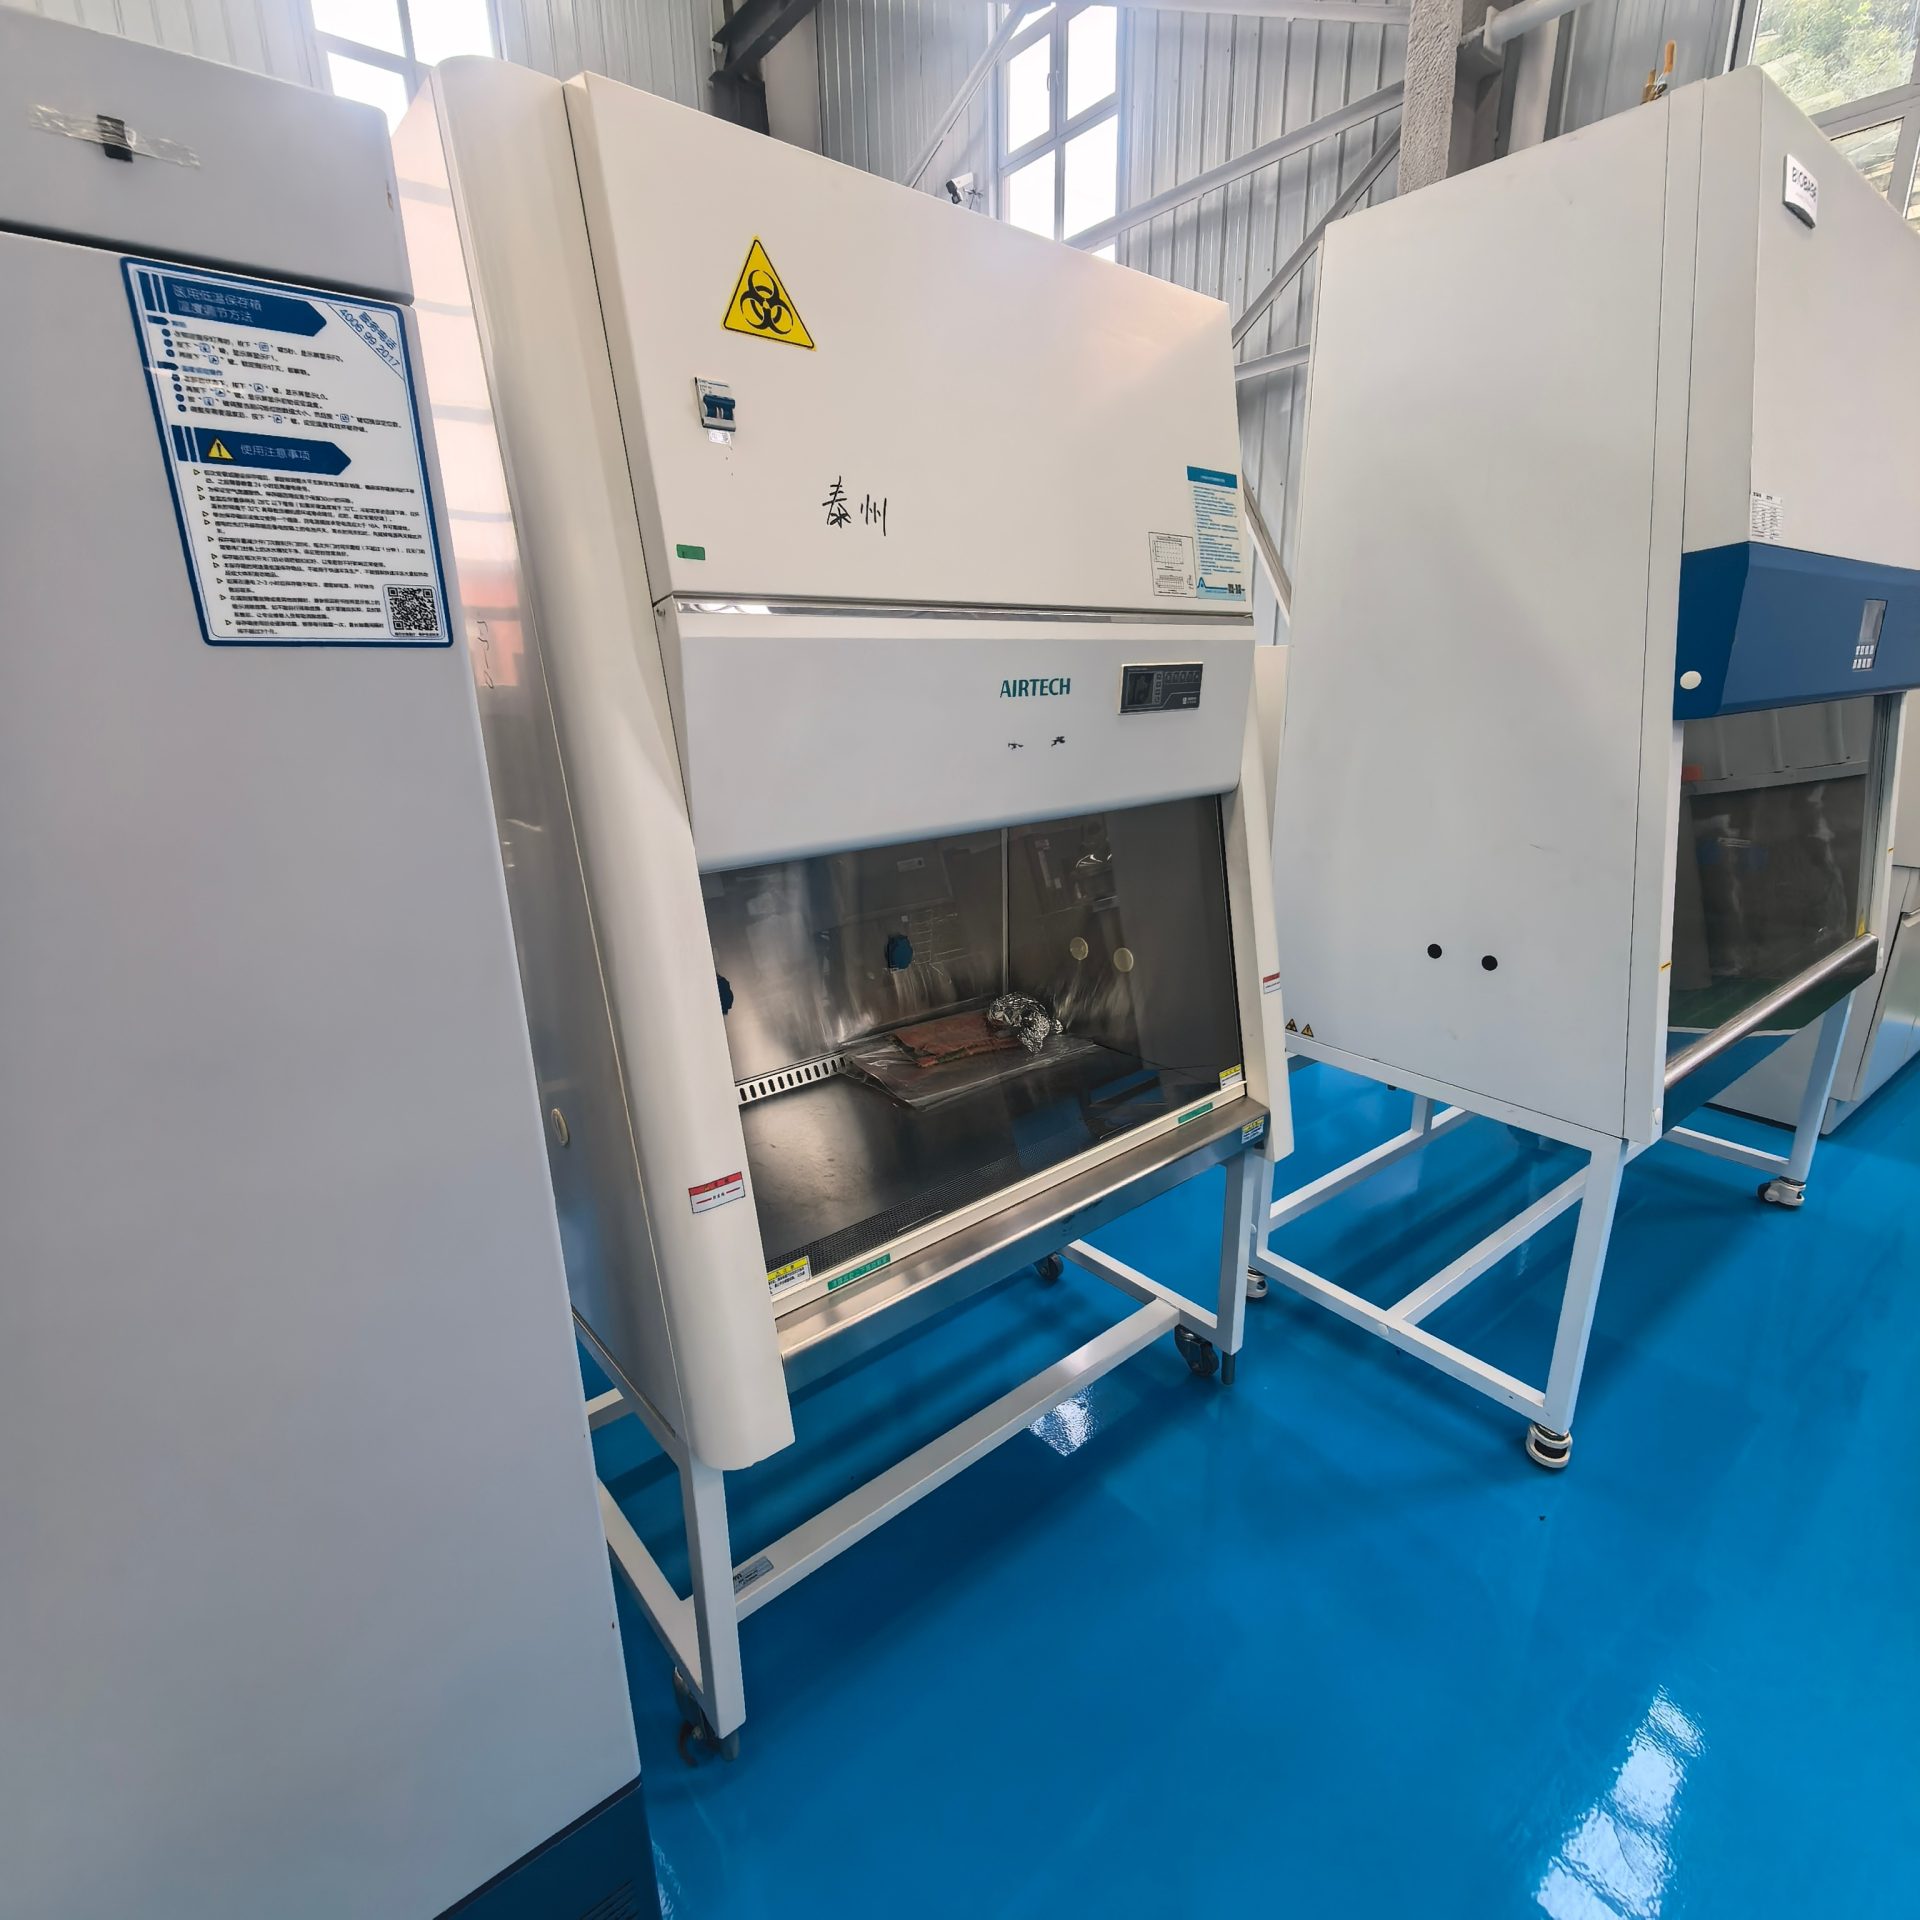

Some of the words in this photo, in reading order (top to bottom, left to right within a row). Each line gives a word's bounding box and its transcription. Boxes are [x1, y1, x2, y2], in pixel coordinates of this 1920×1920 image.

[339, 308, 365, 333] 4006
[363, 331, 378, 346] 99
[375, 344, 401, 367] 2017
[240, 443, 311, 461] 使用注意事项
[999, 677, 1071, 699] AIRTECH
